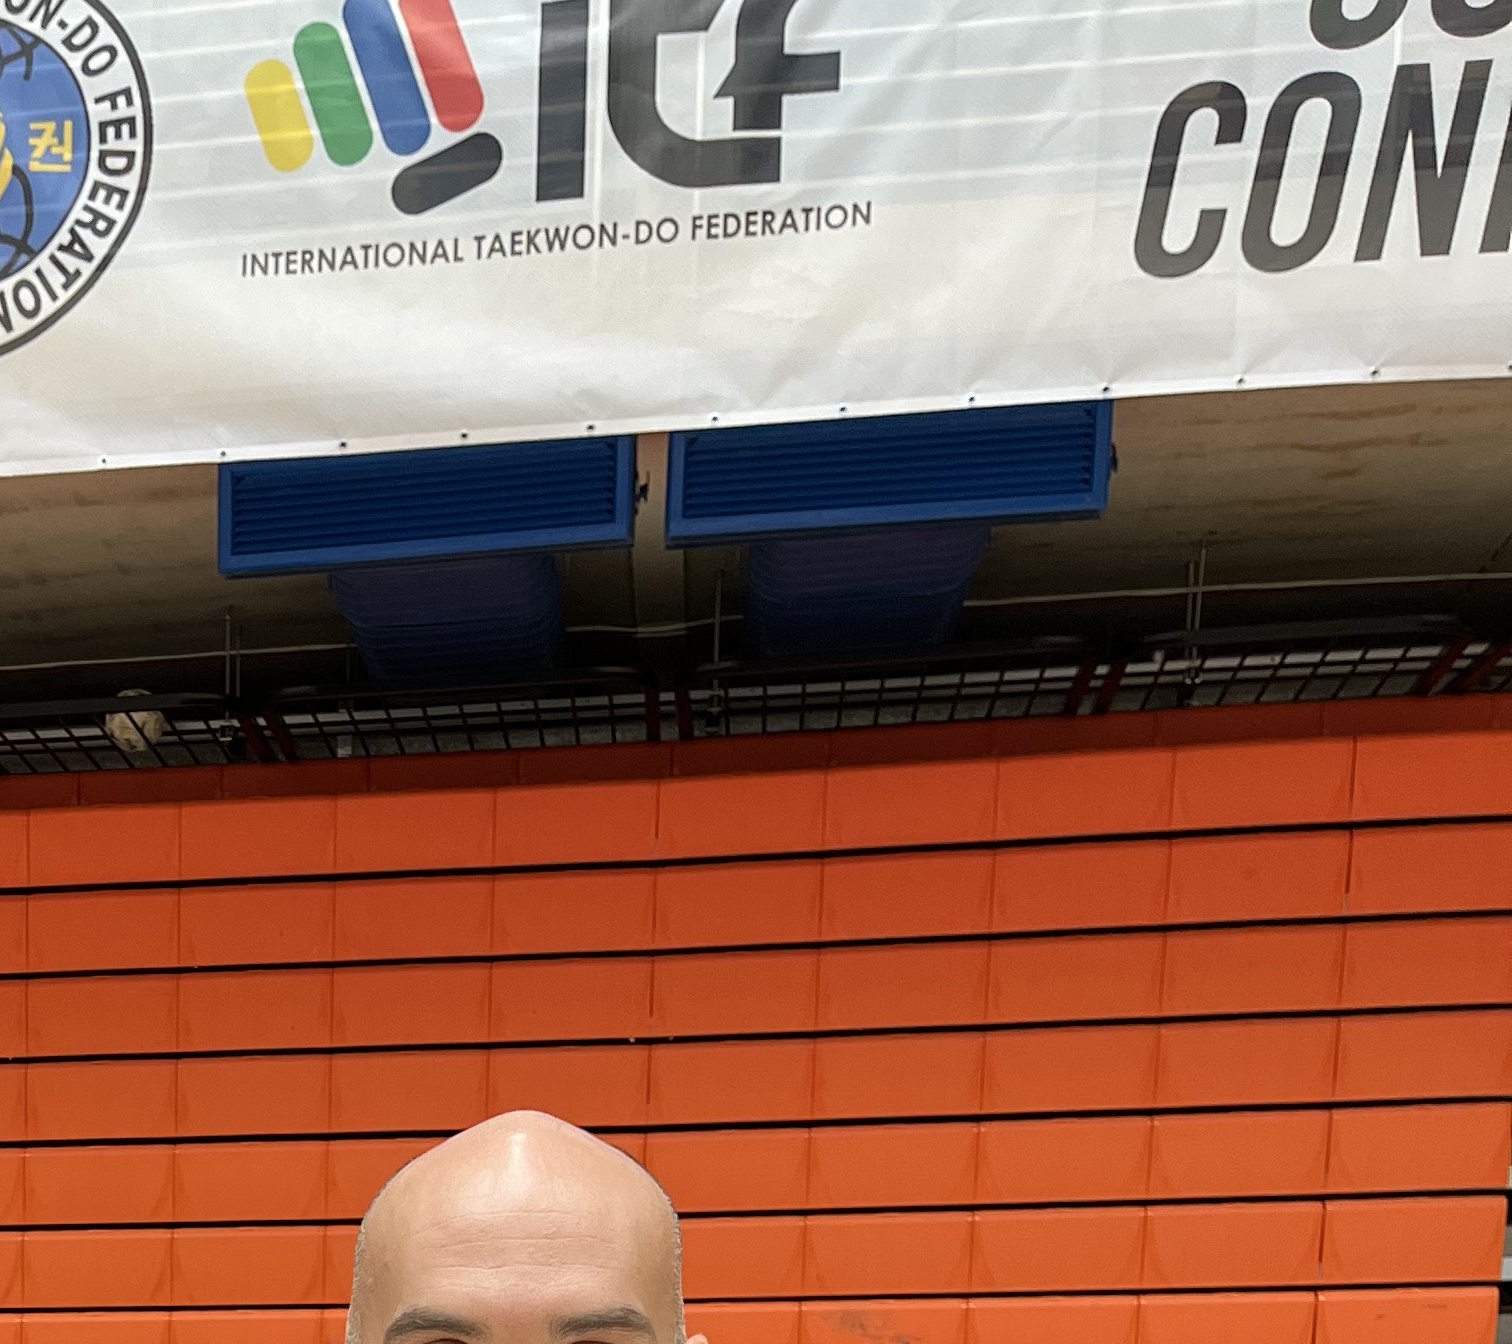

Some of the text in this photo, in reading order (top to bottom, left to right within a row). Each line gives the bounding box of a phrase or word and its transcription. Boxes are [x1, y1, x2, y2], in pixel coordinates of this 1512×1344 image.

[241, 201, 874, 278] INTERNATIONAL TAEKWON-DO FEDERATION
